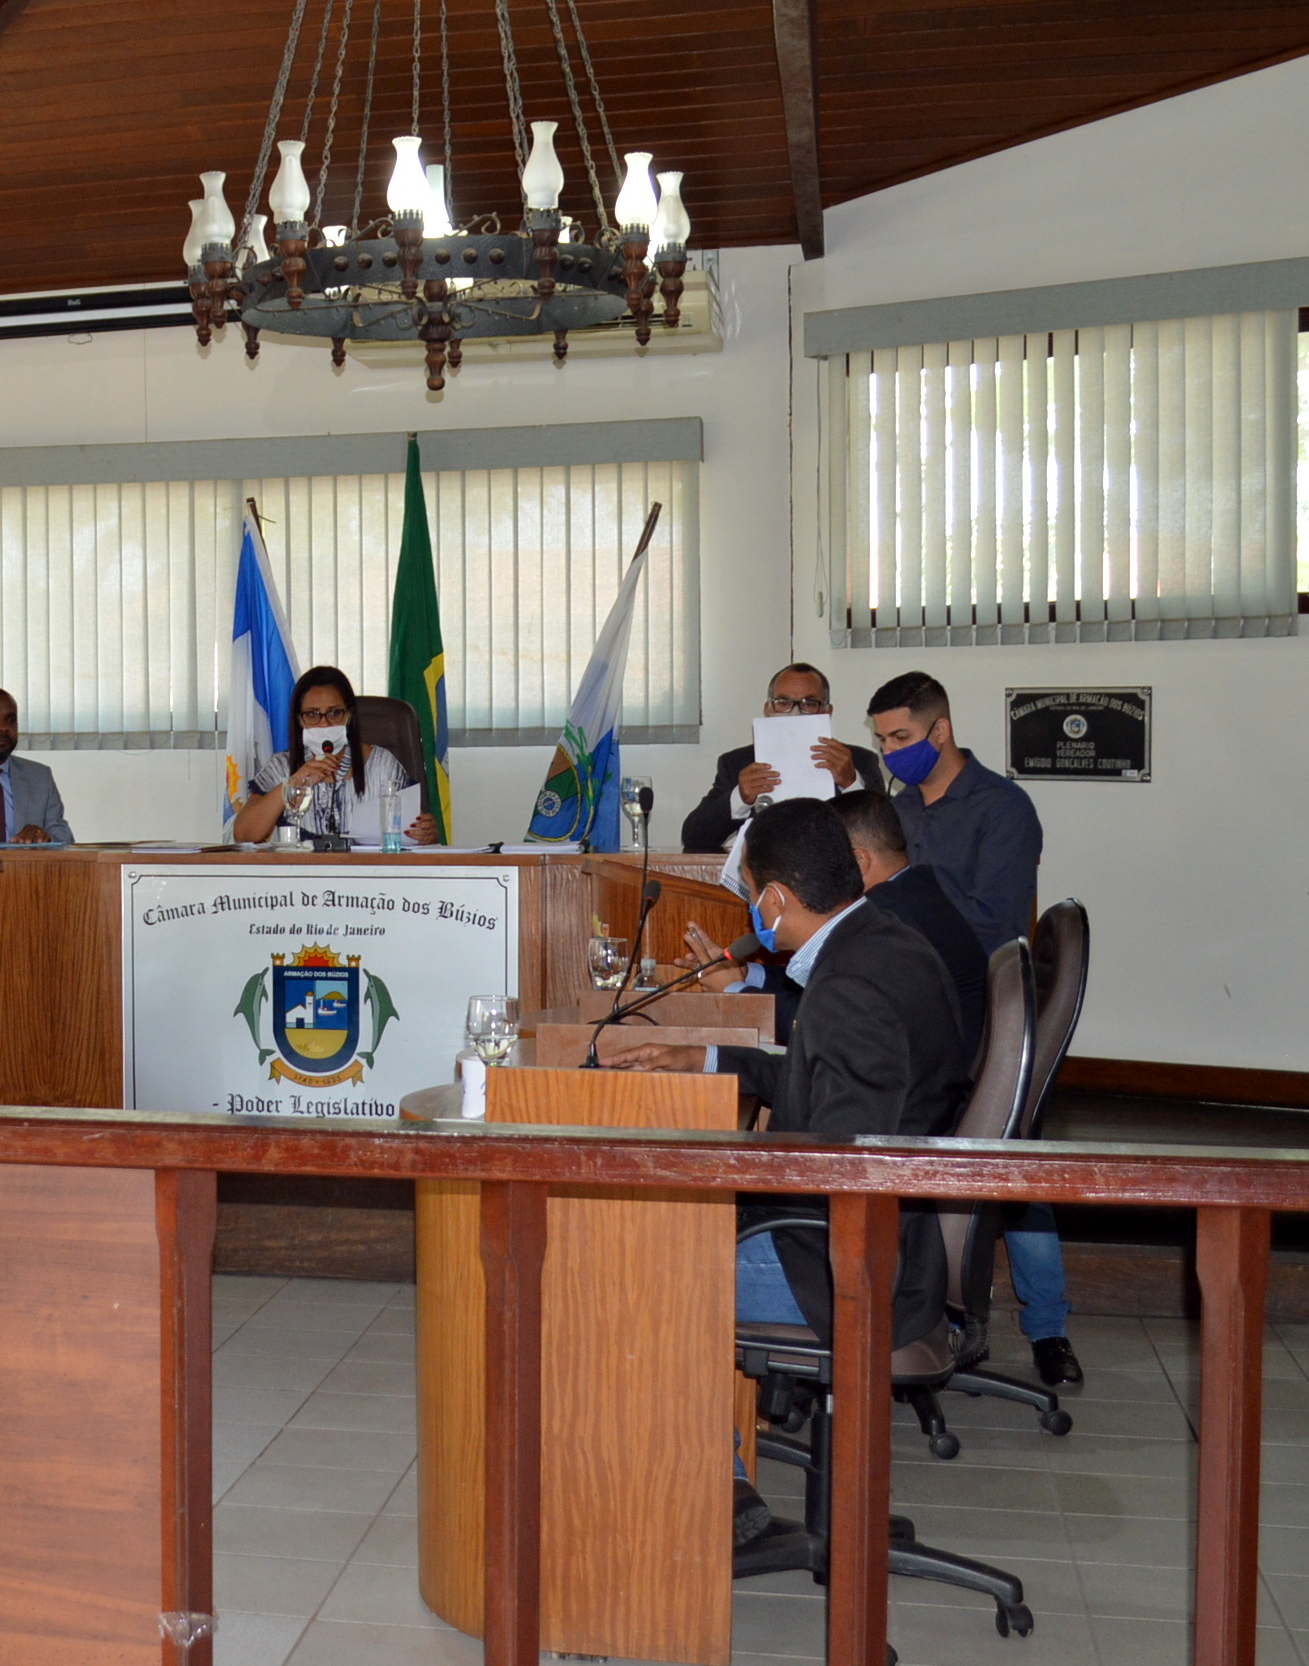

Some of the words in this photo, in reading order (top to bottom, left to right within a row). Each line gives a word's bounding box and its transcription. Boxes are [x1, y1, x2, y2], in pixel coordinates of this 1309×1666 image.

[1056, 749, 1096, 757] VEREADOR
[143, 904, 207, 926] Câmara
[211, 891, 295, 915] Municipal
[300, 891, 318, 907] de
[322, 889, 396, 915] Armação
[401, 896, 432, 915] dos
[435, 899, 499, 931] Búzios
[249, 923, 286, 936] Estado
[289, 923, 303, 936] do
[306, 923, 325, 936] Rio
[325, 924, 340, 936] de
[342, 923, 386, 937] Janeiro
[283, 970, 313, 978] ARMAÇÃO
[327, 970, 349, 978] BÚZIOS
[227, 1092, 283, 1115] Poder
[289, 1094, 396, 1118] Legislativo
